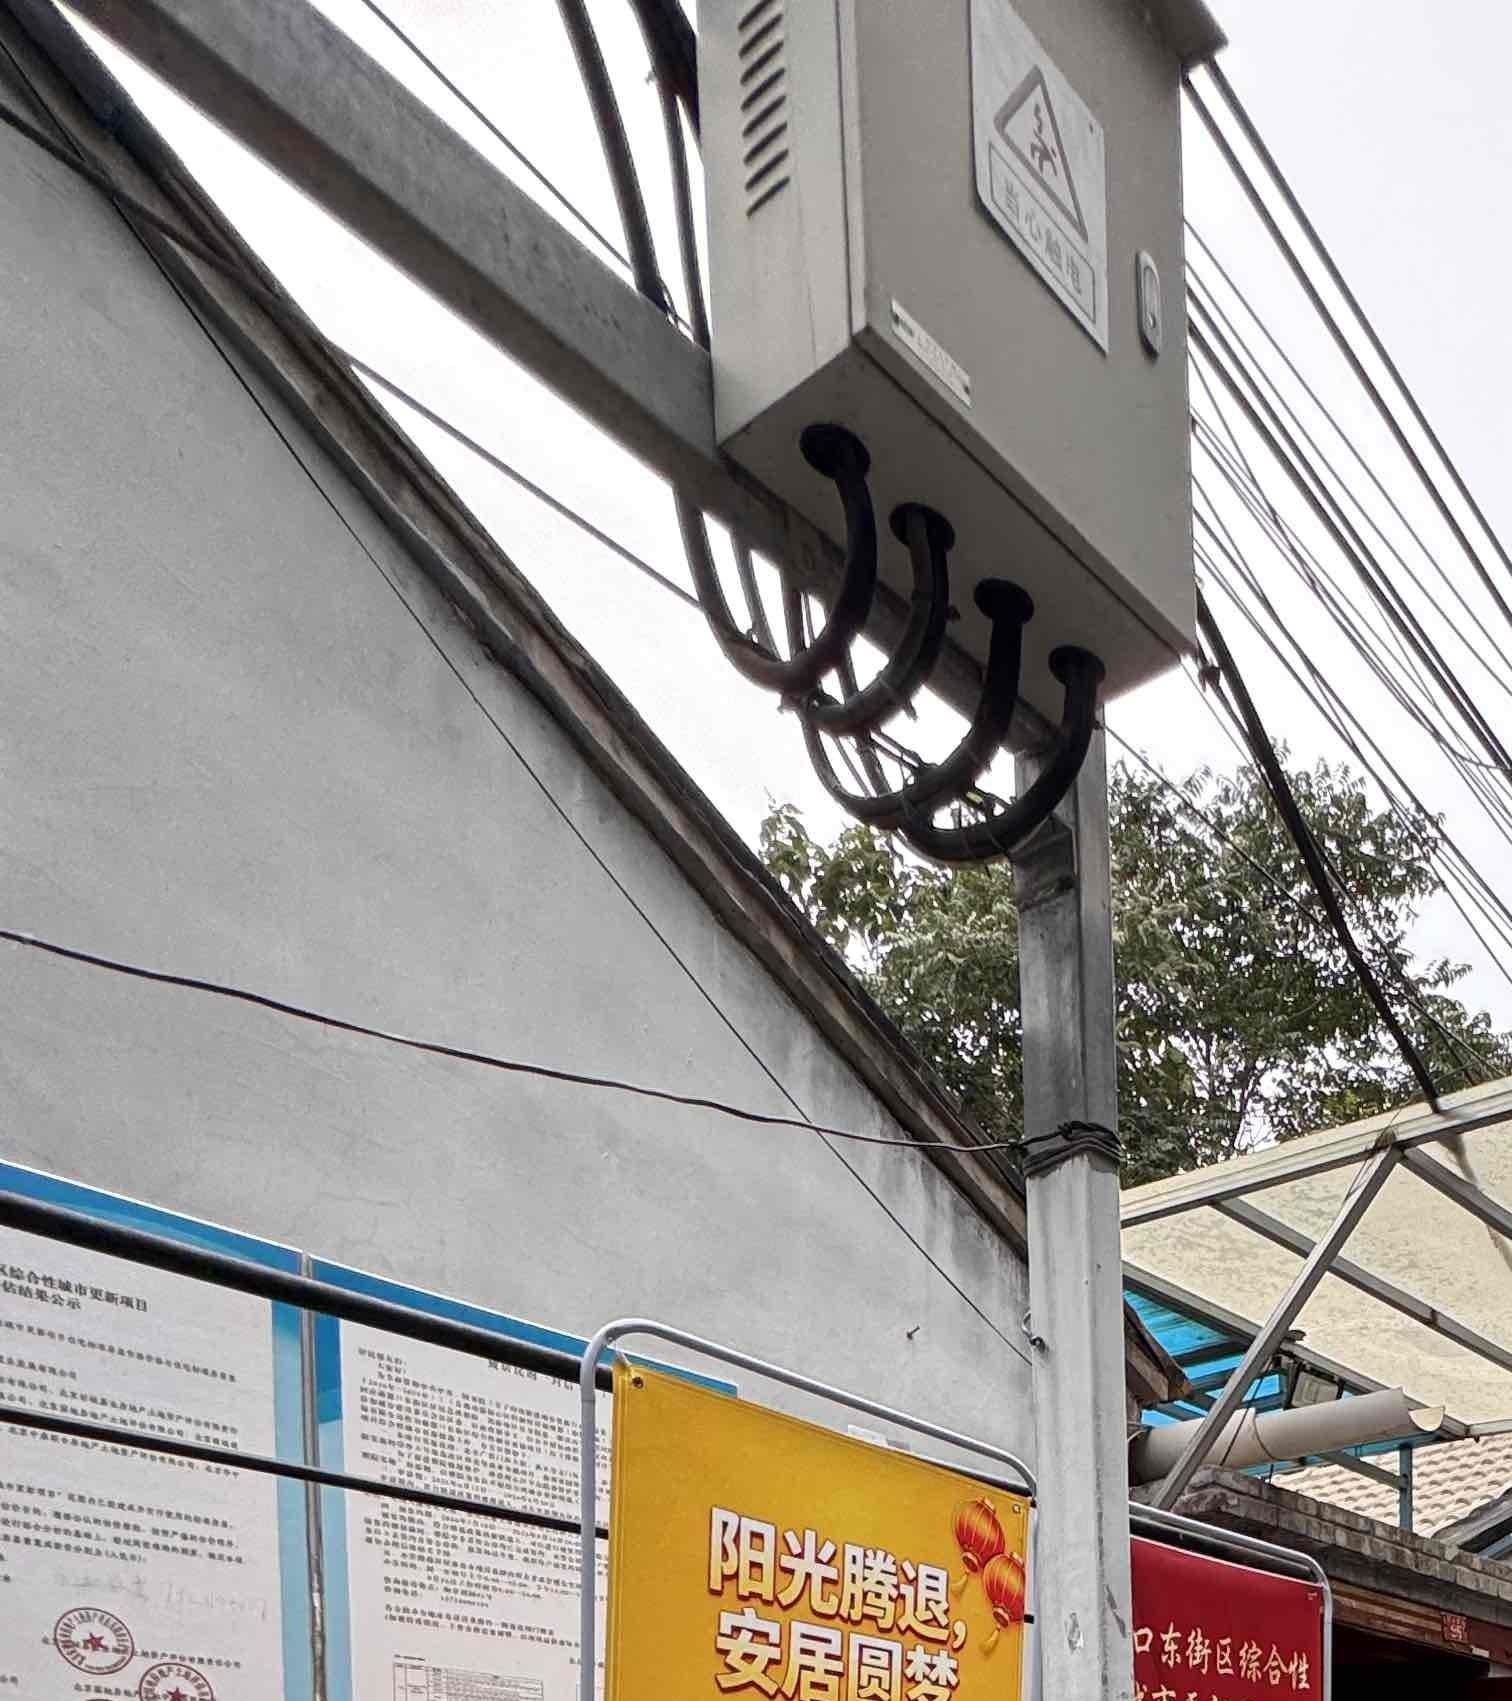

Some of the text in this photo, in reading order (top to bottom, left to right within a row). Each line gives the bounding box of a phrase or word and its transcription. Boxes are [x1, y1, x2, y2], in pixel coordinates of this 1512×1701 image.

[715, 1607, 959, 1701] 安居圆梦
[1133, 1621, 1311, 1691] 口东街区综合性
